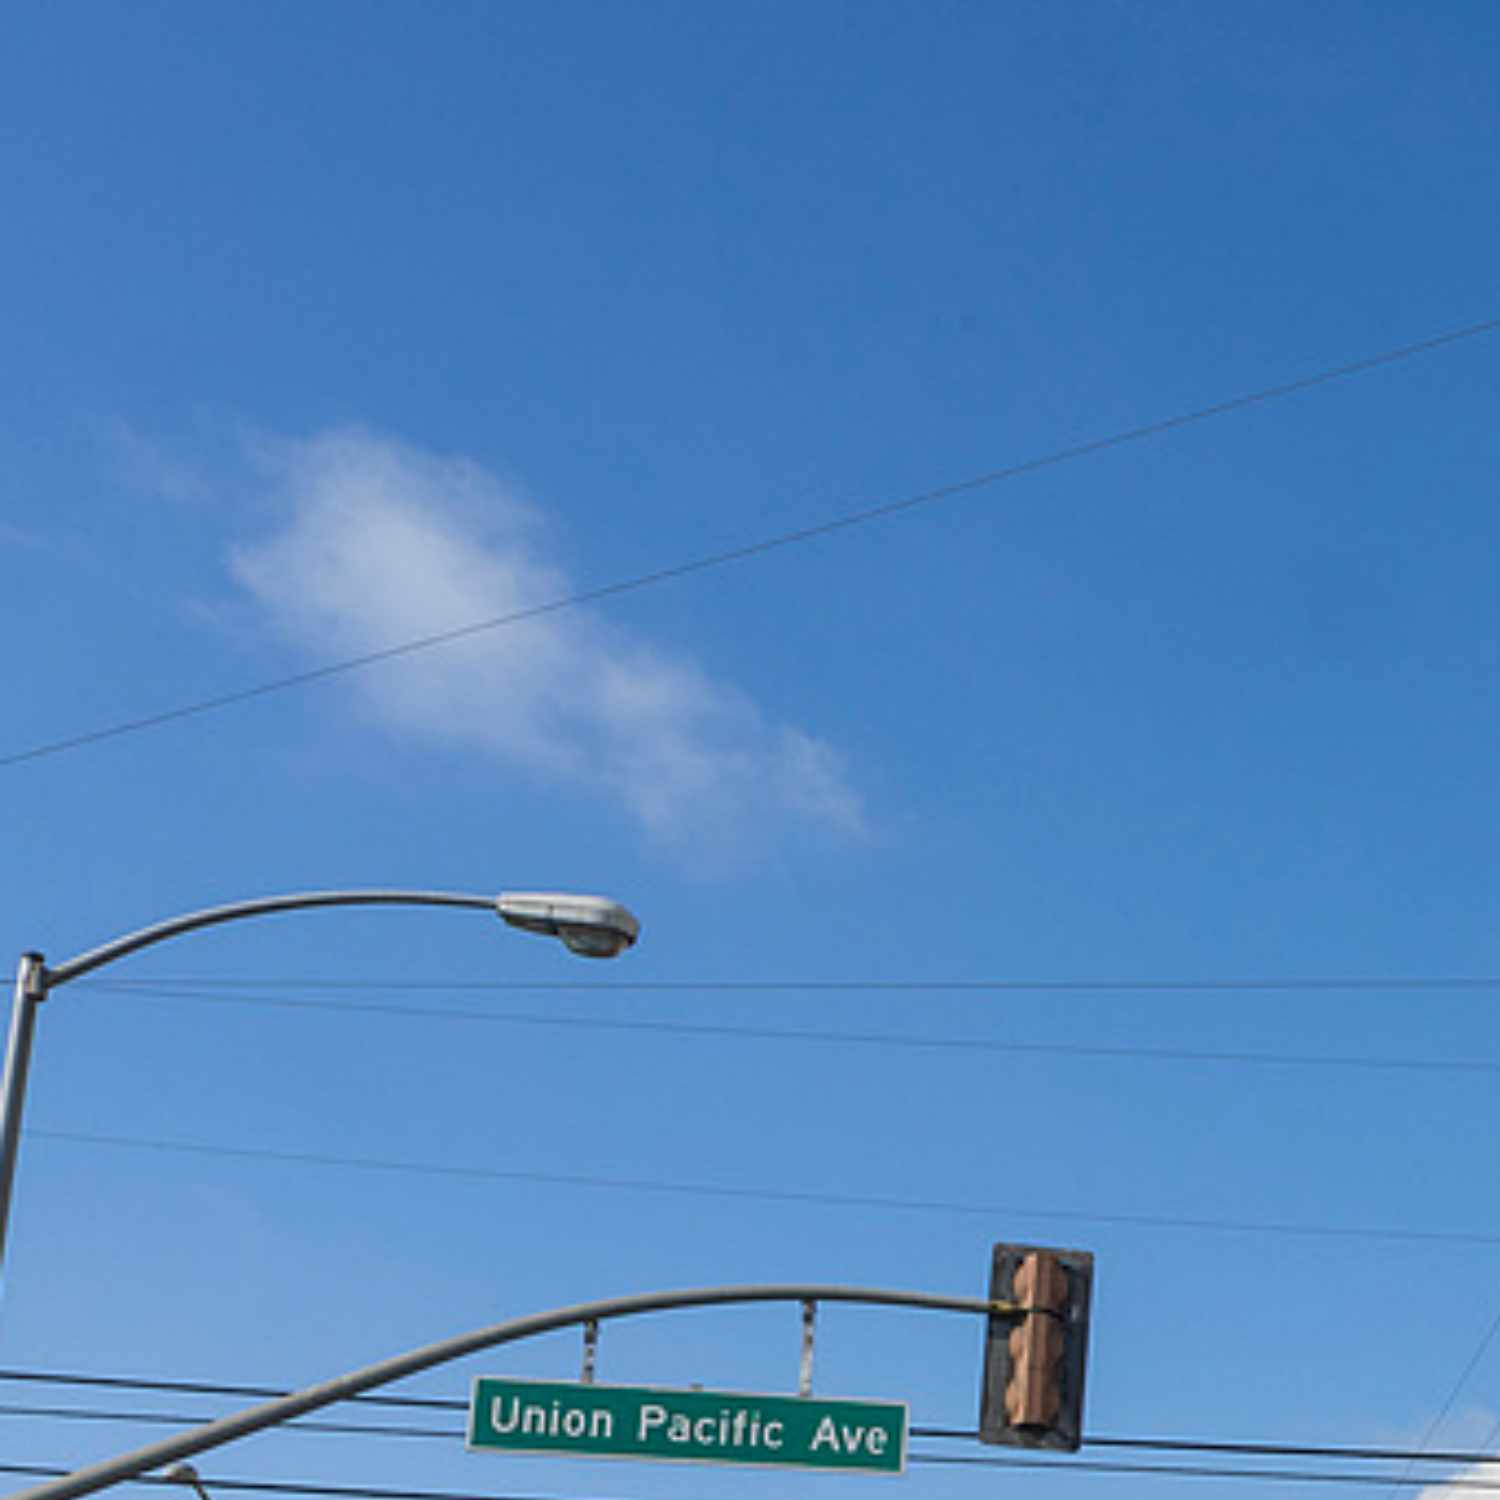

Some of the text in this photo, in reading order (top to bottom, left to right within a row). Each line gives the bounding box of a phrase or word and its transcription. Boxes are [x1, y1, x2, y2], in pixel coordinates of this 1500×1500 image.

[489, 1395, 889, 1456] Union Pacific Ave
